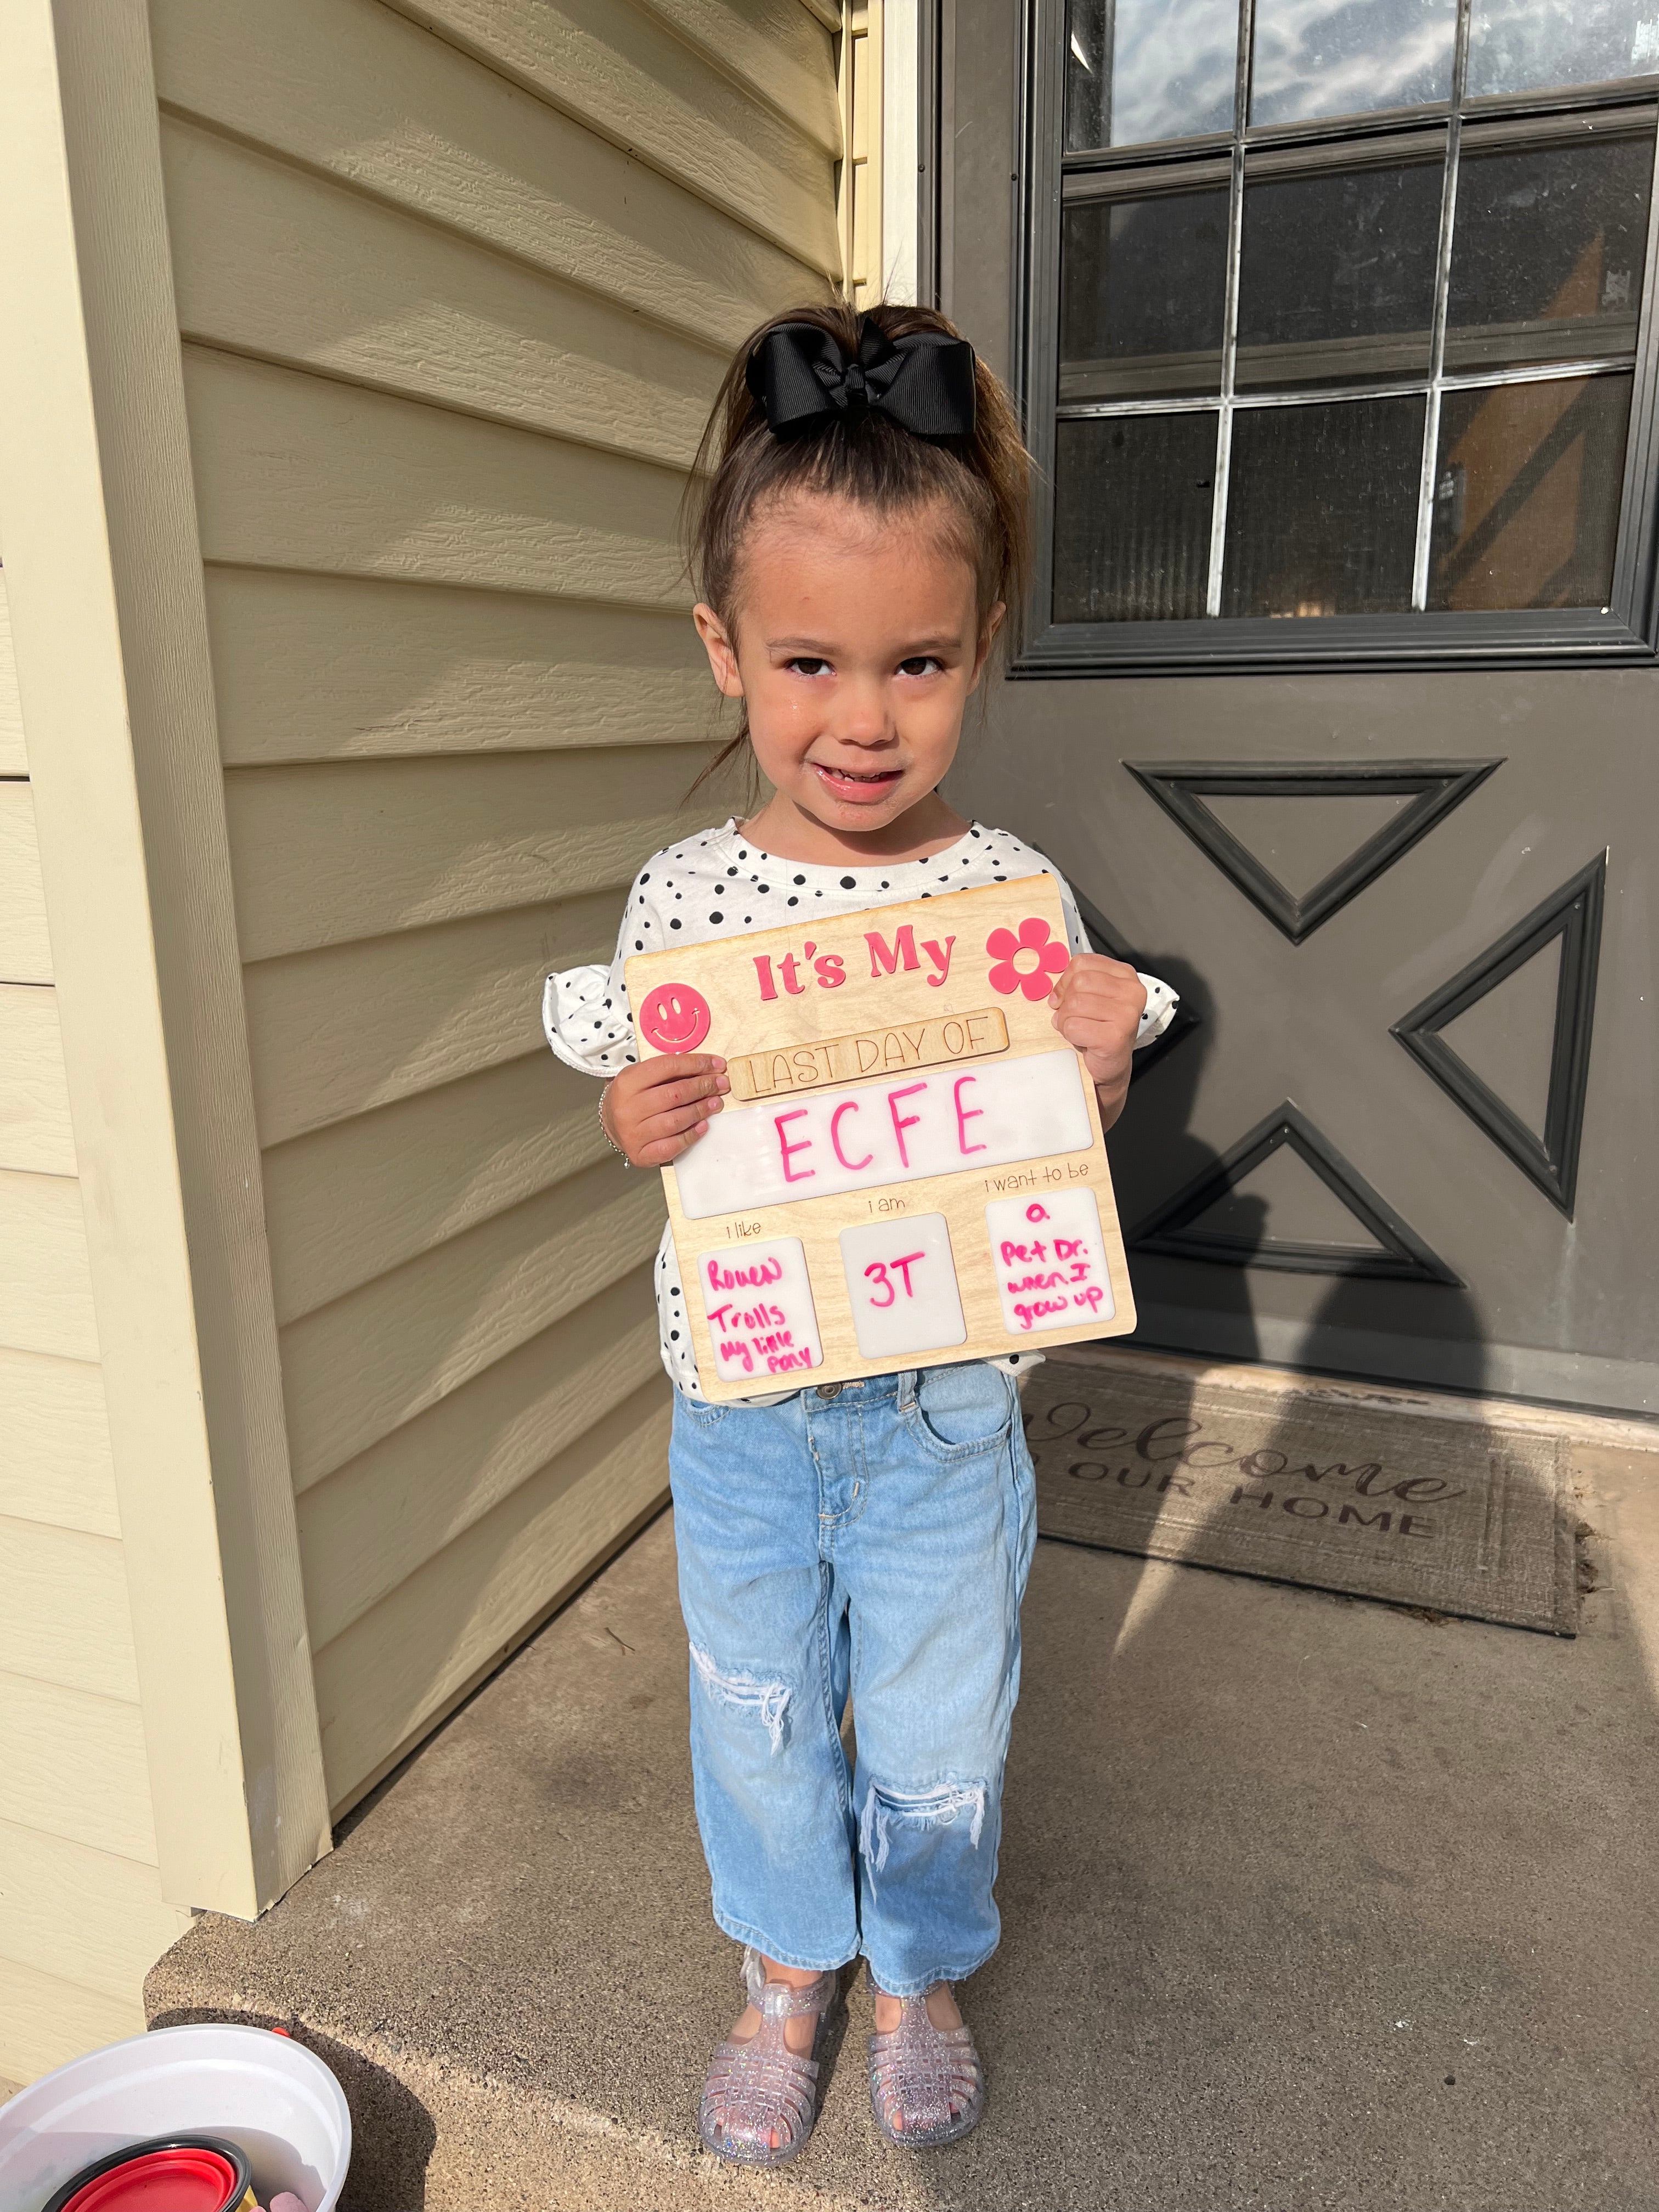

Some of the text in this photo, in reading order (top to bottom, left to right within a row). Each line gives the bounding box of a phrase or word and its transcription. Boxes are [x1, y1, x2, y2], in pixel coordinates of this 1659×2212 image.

[753, 924, 956, 1000] It's My
[749, 1016, 989, 1093] LAST DAY OF
[774, 1076, 987, 1183] ECFE
[993, 1169, 1037, 1191] want
[1043, 1166, 1062, 1183] to
[1068, 1163, 1088, 1178] be
[878, 1197, 906, 1211] am
[735, 1221, 761, 1238] like
[1053, 1239, 1088, 1261] Dr.
[1070, 1263, 1091, 1282] I
[707, 1303, 786, 1333] Trolls
[1013, 1286, 1104, 1330] grow up
[1068, 1462, 1438, 1538] OUR HOME
